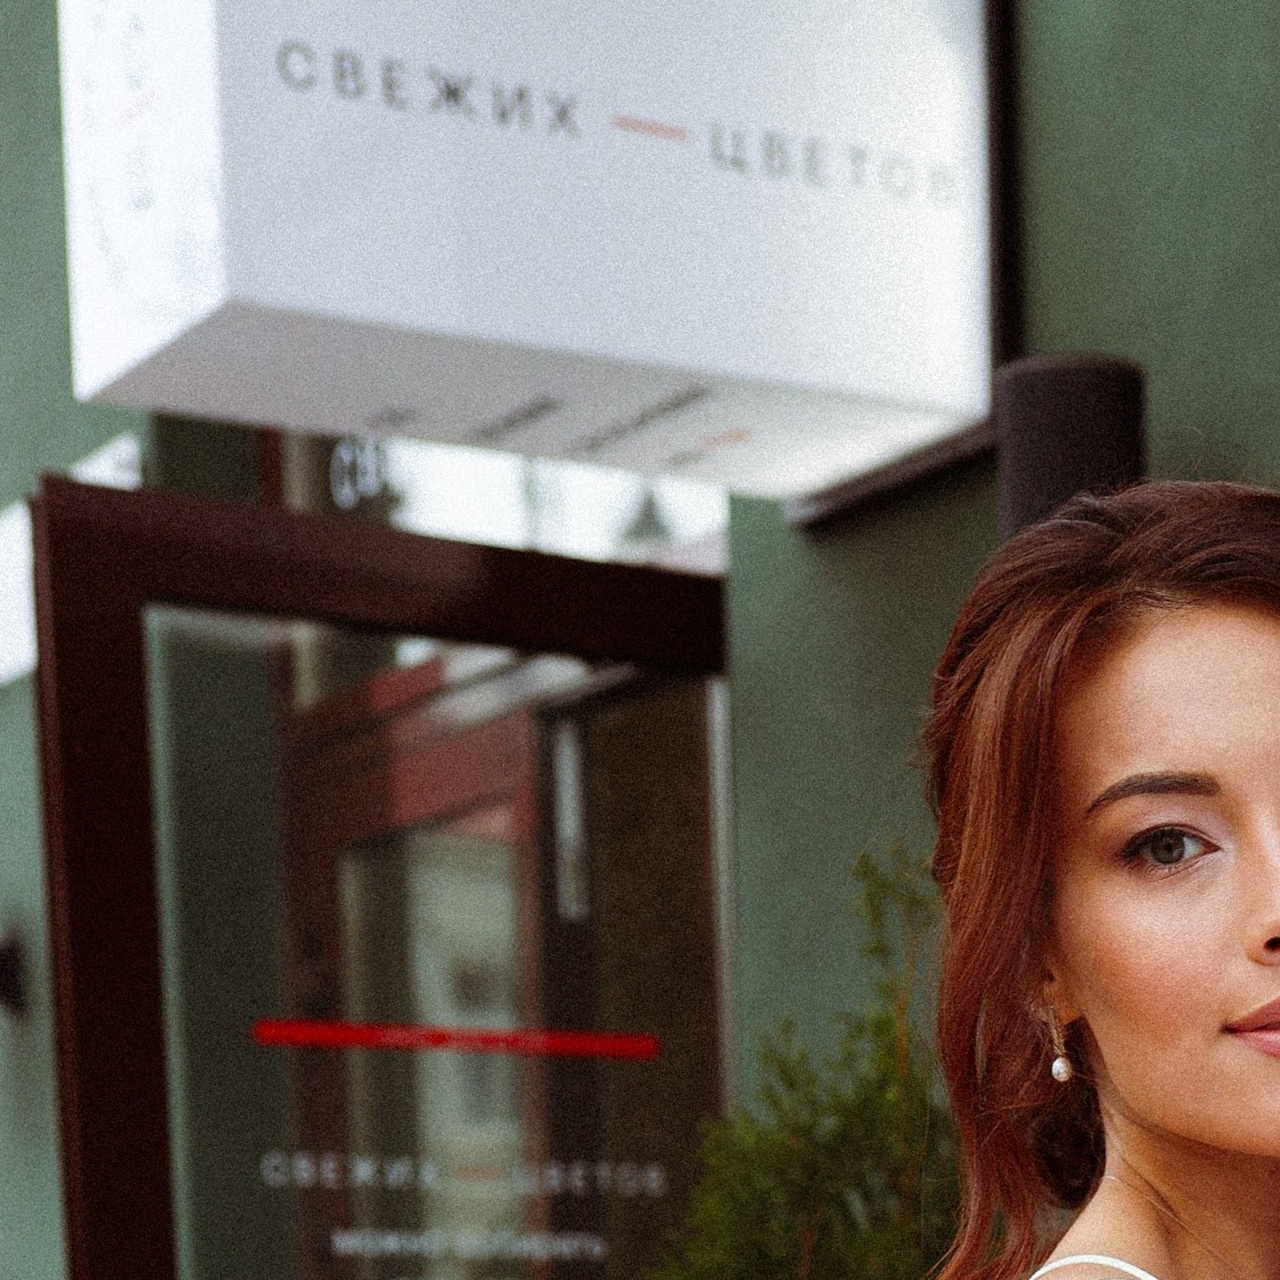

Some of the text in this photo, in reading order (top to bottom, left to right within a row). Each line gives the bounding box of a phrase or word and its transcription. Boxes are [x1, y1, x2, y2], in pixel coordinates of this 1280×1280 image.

[274, 38, 959, 208] СВЕЖИХ ЦВЕТОВ
[259, 1150, 439, 1190] СВЕЖИХ
